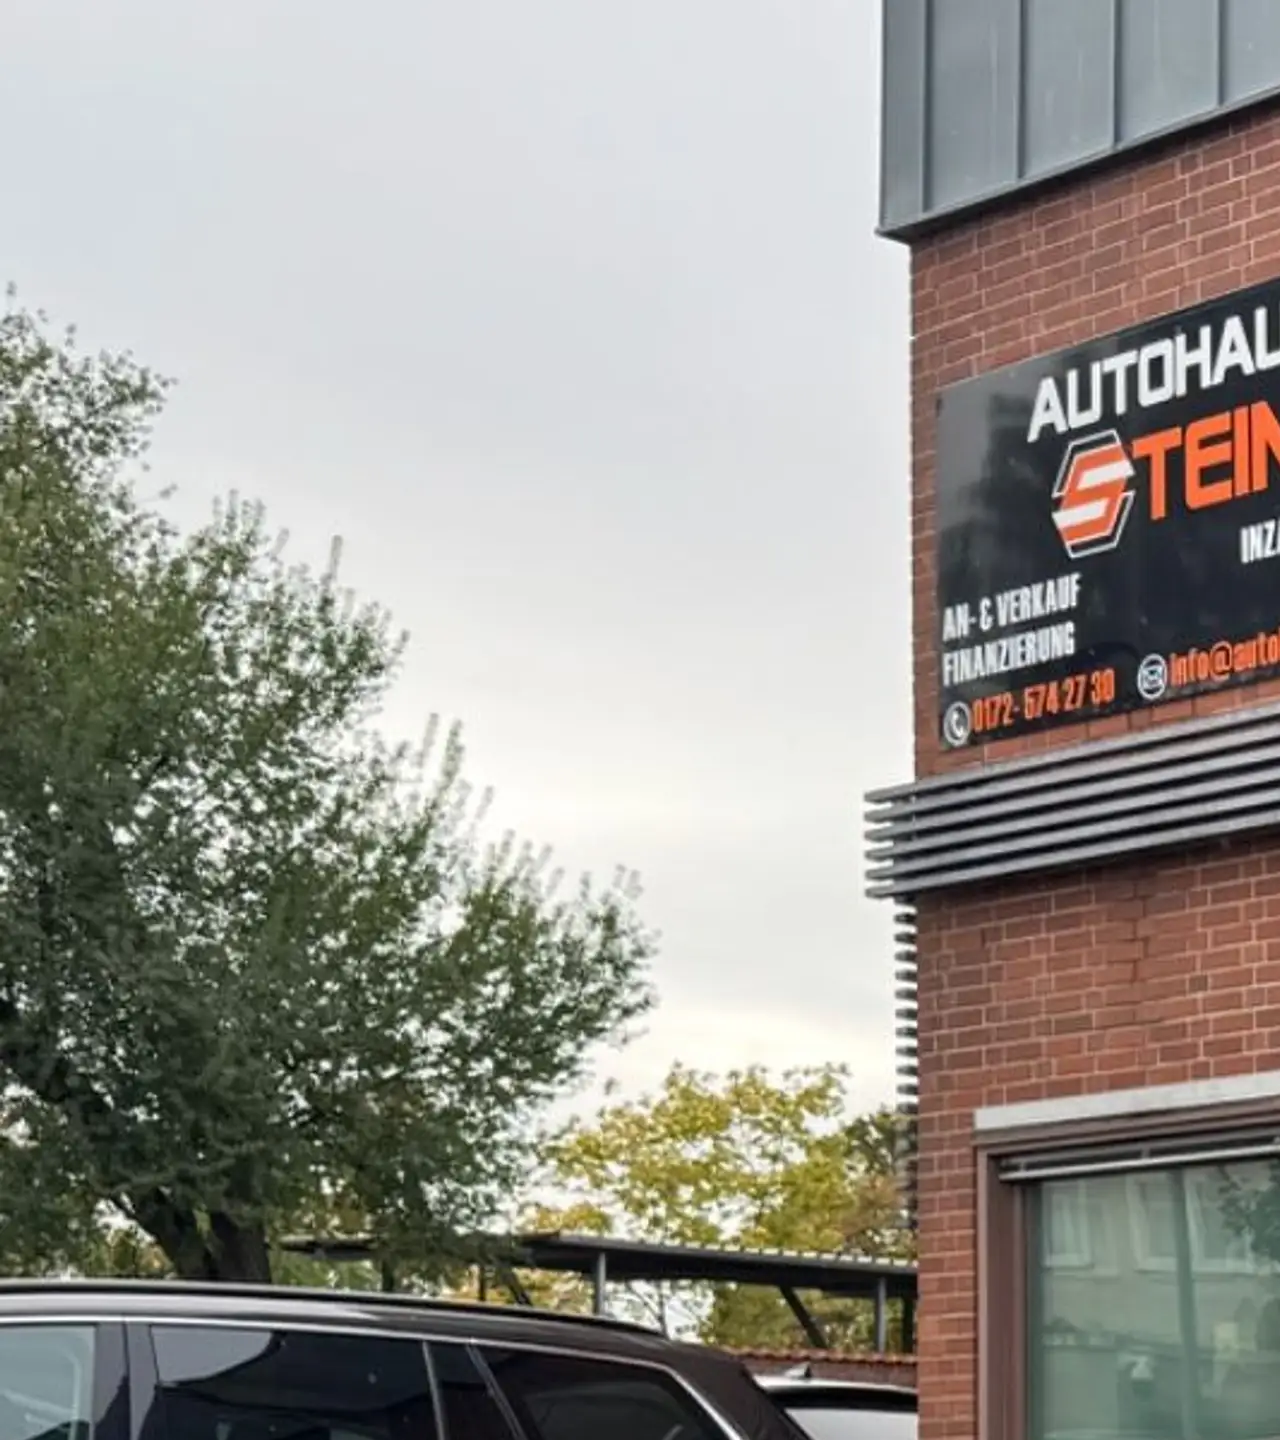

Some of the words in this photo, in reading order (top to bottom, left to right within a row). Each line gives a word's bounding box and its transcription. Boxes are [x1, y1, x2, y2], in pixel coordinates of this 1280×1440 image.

[943, 603, 977, 642] AN-
[996, 572, 1082, 626] VERKAUF
[943, 621, 1076, 688] FINANZIERUNG
[1063, 674, 1087, 711] 27
